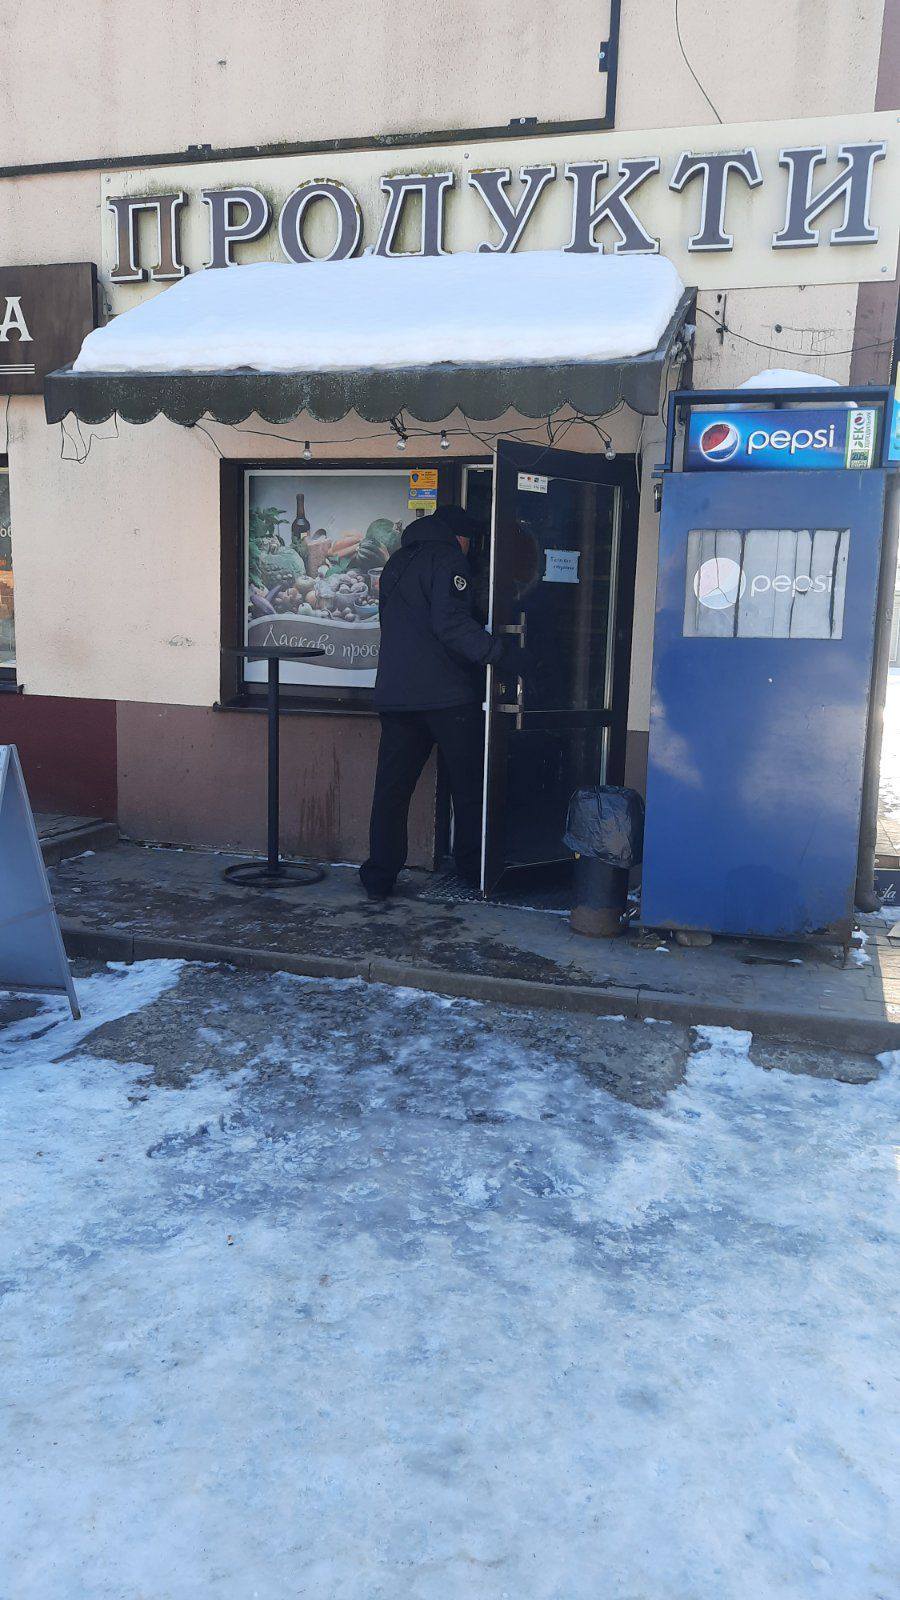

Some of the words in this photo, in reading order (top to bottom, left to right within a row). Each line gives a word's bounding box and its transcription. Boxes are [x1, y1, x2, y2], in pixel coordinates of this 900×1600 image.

[107, 140, 888, 284] ПРОДУКТИ
[747, 424, 835, 455] pepsi
[751, 570, 833, 597] pepsi
[342, 643, 380, 664] прос
